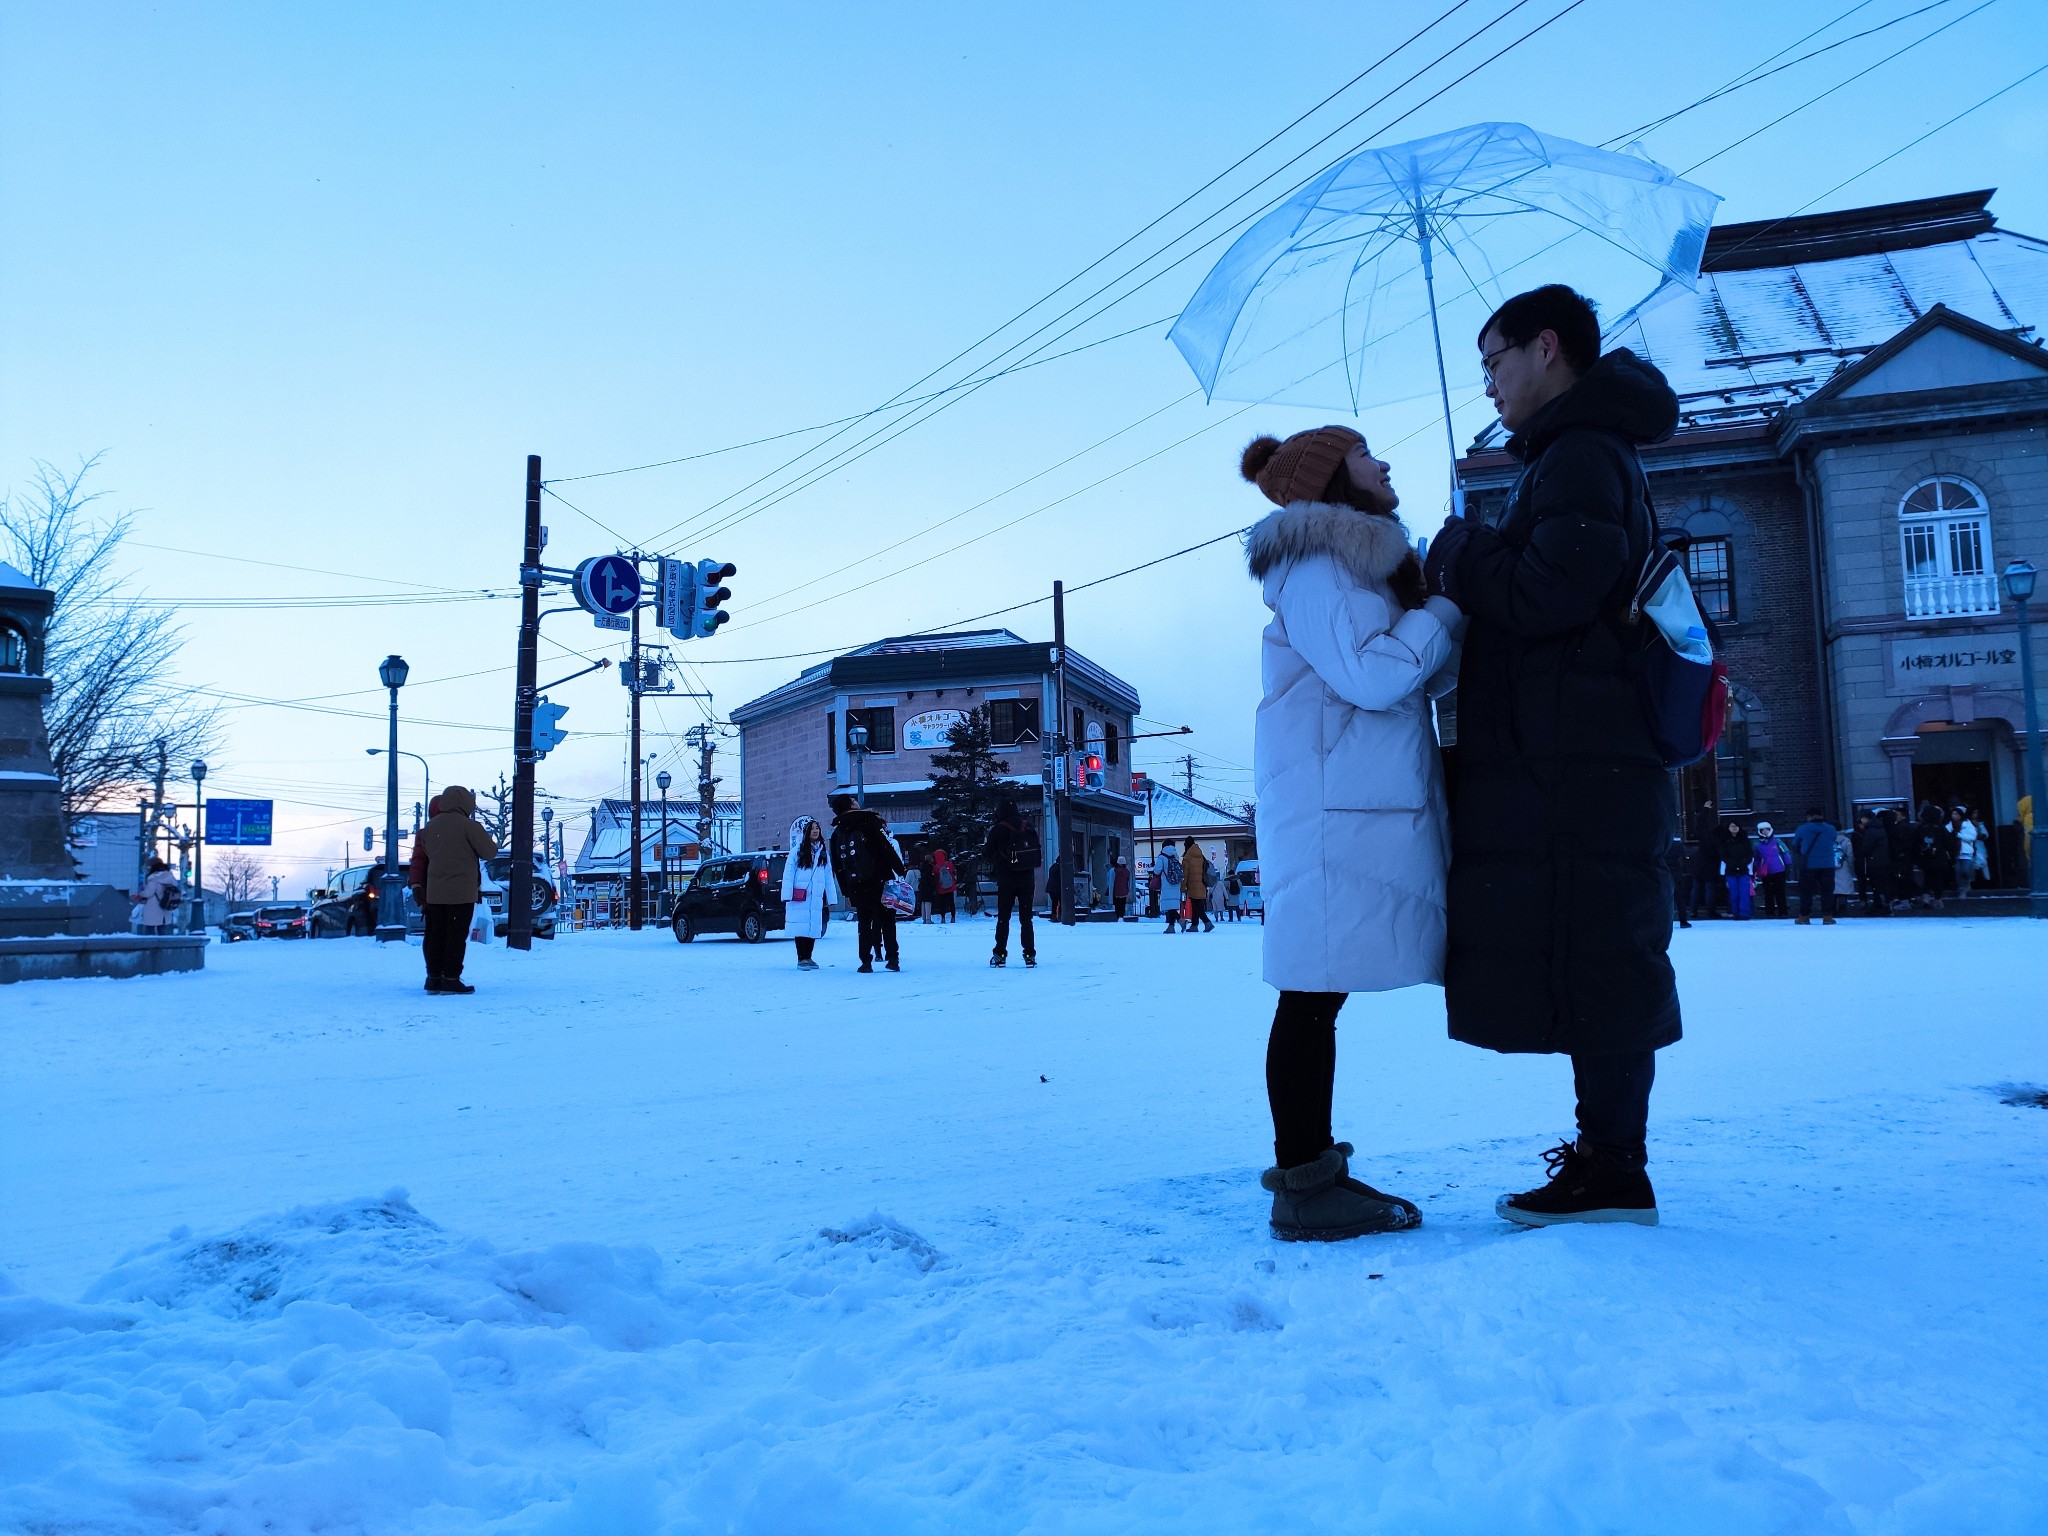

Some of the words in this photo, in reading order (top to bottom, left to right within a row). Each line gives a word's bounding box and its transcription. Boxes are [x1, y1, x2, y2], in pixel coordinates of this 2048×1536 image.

[1899, 649, 2017, 671] 小樽オルゴール堂
[910, 712, 959, 727] 小樽オルゴー
